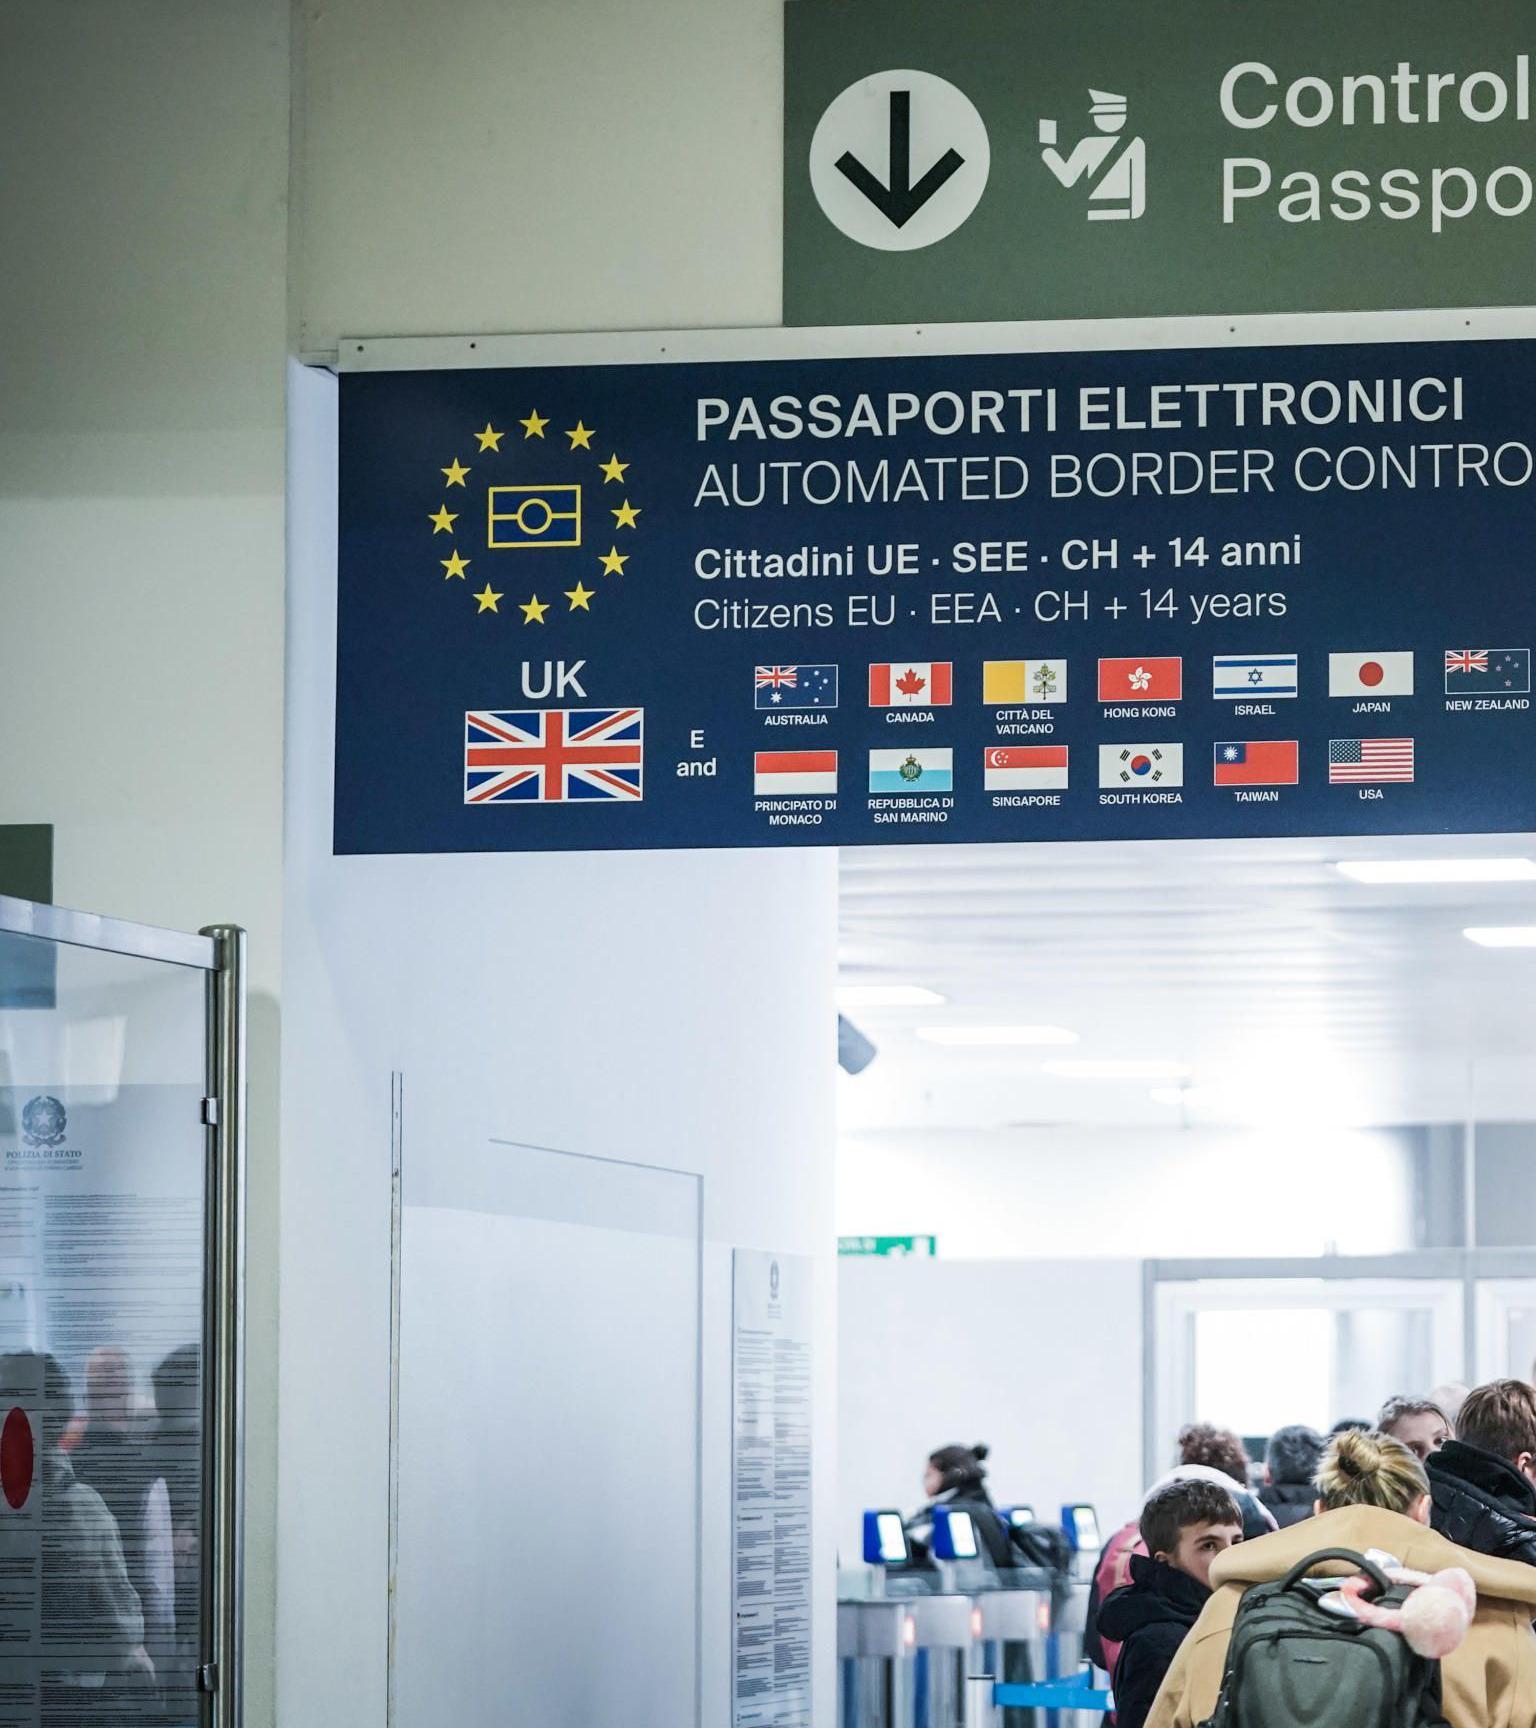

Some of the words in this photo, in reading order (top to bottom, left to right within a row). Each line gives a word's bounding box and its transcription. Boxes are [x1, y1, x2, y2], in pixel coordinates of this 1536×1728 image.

[697, 388, 1057, 442] PASSAPORTI
[1079, 377, 1463, 431] ELETTRONICI
[693, 456, 1029, 508] AUTOMATED
[1050, 449, 1275, 498] BORDER
[694, 545, 853, 580] Cittadini
[867, 543, 920, 576] UE
[952, 540, 1028, 573] SEE
[1061, 538, 1118, 571] CH
[1132, 545, 1157, 569] +
[1168, 536, 1210, 568] 14
[1221, 534, 1301, 567] anni
[694, 598, 834, 630] Citizens
[848, 594, 895, 626] EU
[931, 592, 1002, 624] EEA
[1034, 590, 1088, 622] CH
[1104, 596, 1128, 620] +
[1140, 587, 1179, 619] 14
[1189, 592, 1287, 625] years
[521, 659, 588, 699] UK
[1234, 704, 1276, 716] ISRAEL
[1352, 701, 1391, 714] JAPAN
[1445, 700, 1473, 711] NEW
[1474, 698, 1530, 711] ZEALAND
[885, 712, 935, 723] CANADA
[995, 707, 1030, 721] CITTÀ
[1031, 709, 1055, 720] DEL
[1103, 707, 1140, 719] HONG
[1141, 706, 1176, 718] KONG
[764, 714, 829, 726] AUSTRALIA
[995, 723, 1054, 735] VATICANO
[690, 729, 705, 749] E
[676, 757, 717, 777] and
[1099, 793, 1141, 805] SOUTH
[1142, 792, 1183, 804] KOREA
[1233, 790, 1279, 802] TAIWAN
[1358, 788, 1384, 800] USA
[754, 799, 823, 812] PRINCIPATO
[824, 799, 837, 811] DI
[867, 797, 941, 810] REPUBBLICA
[942, 797, 954, 808] DI
[992, 795, 1061, 807] SINGAPORE
[768, 813, 823, 826] MONACO
[873, 812, 899, 824] SAN
[900, 811, 948, 823] MARINO
[54, 1150, 82, 1158] STATO
